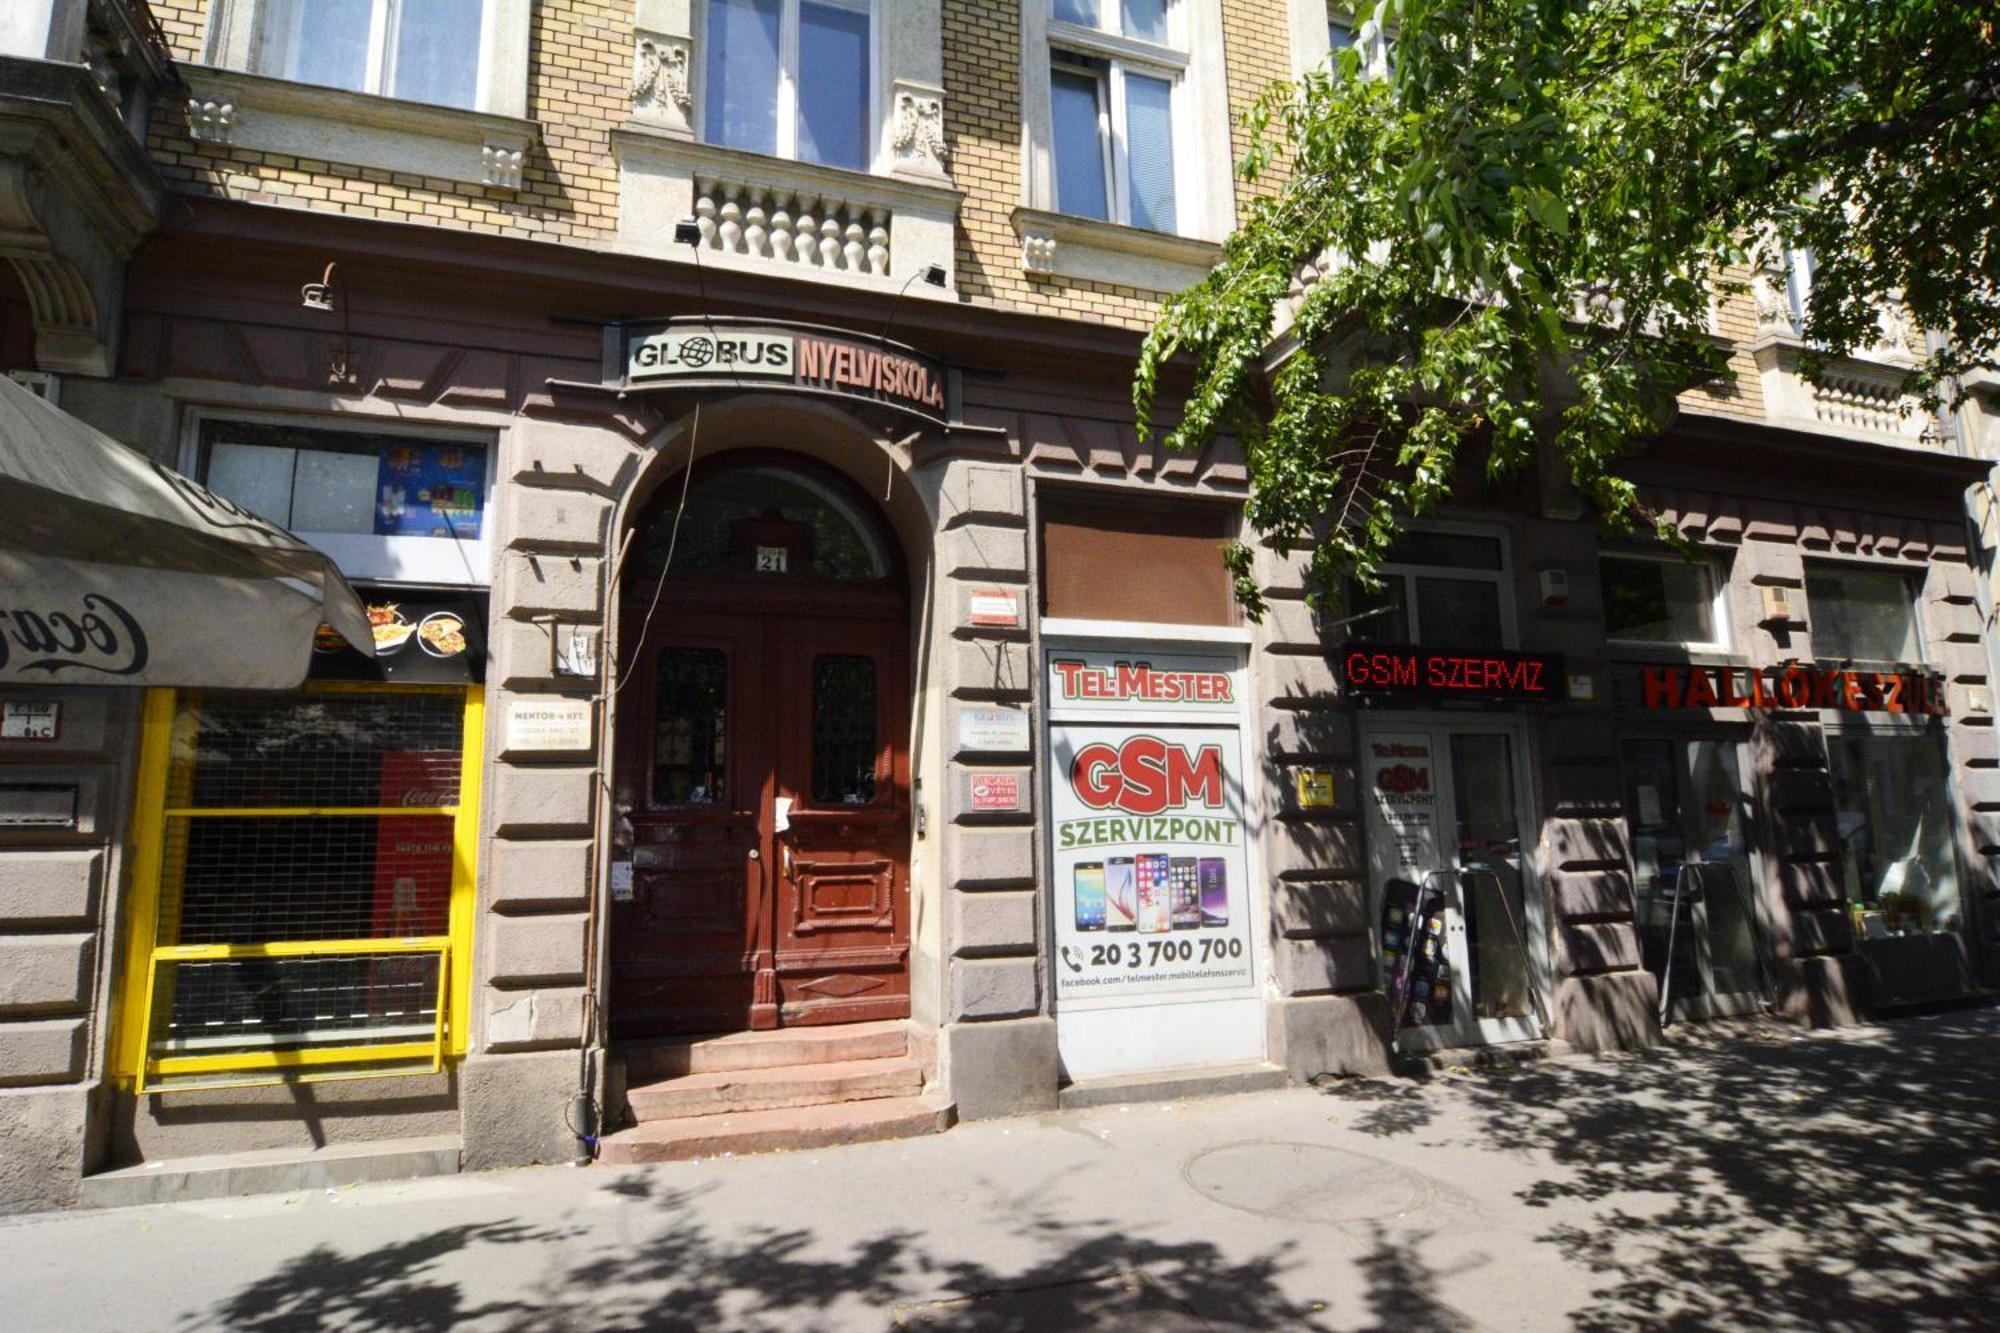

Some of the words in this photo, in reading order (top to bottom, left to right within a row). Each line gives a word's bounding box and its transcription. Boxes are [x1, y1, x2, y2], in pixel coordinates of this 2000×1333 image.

[800, 340, 945, 410] NYELVISKOLA
[761, 555, 781, 570] 21
[1347, 653, 1416, 686] GSM
[1428, 657, 1545, 691] SZERVIZ
[1070, 735, 1224, 816] GSM
[1060, 818, 1237, 846] SZERVIZPONT
[1091, 943, 1121, 965] 20
[1128, 943, 1142, 968] 3
[1148, 940, 1193, 967] 700
[1200, 937, 1242, 963] 700
